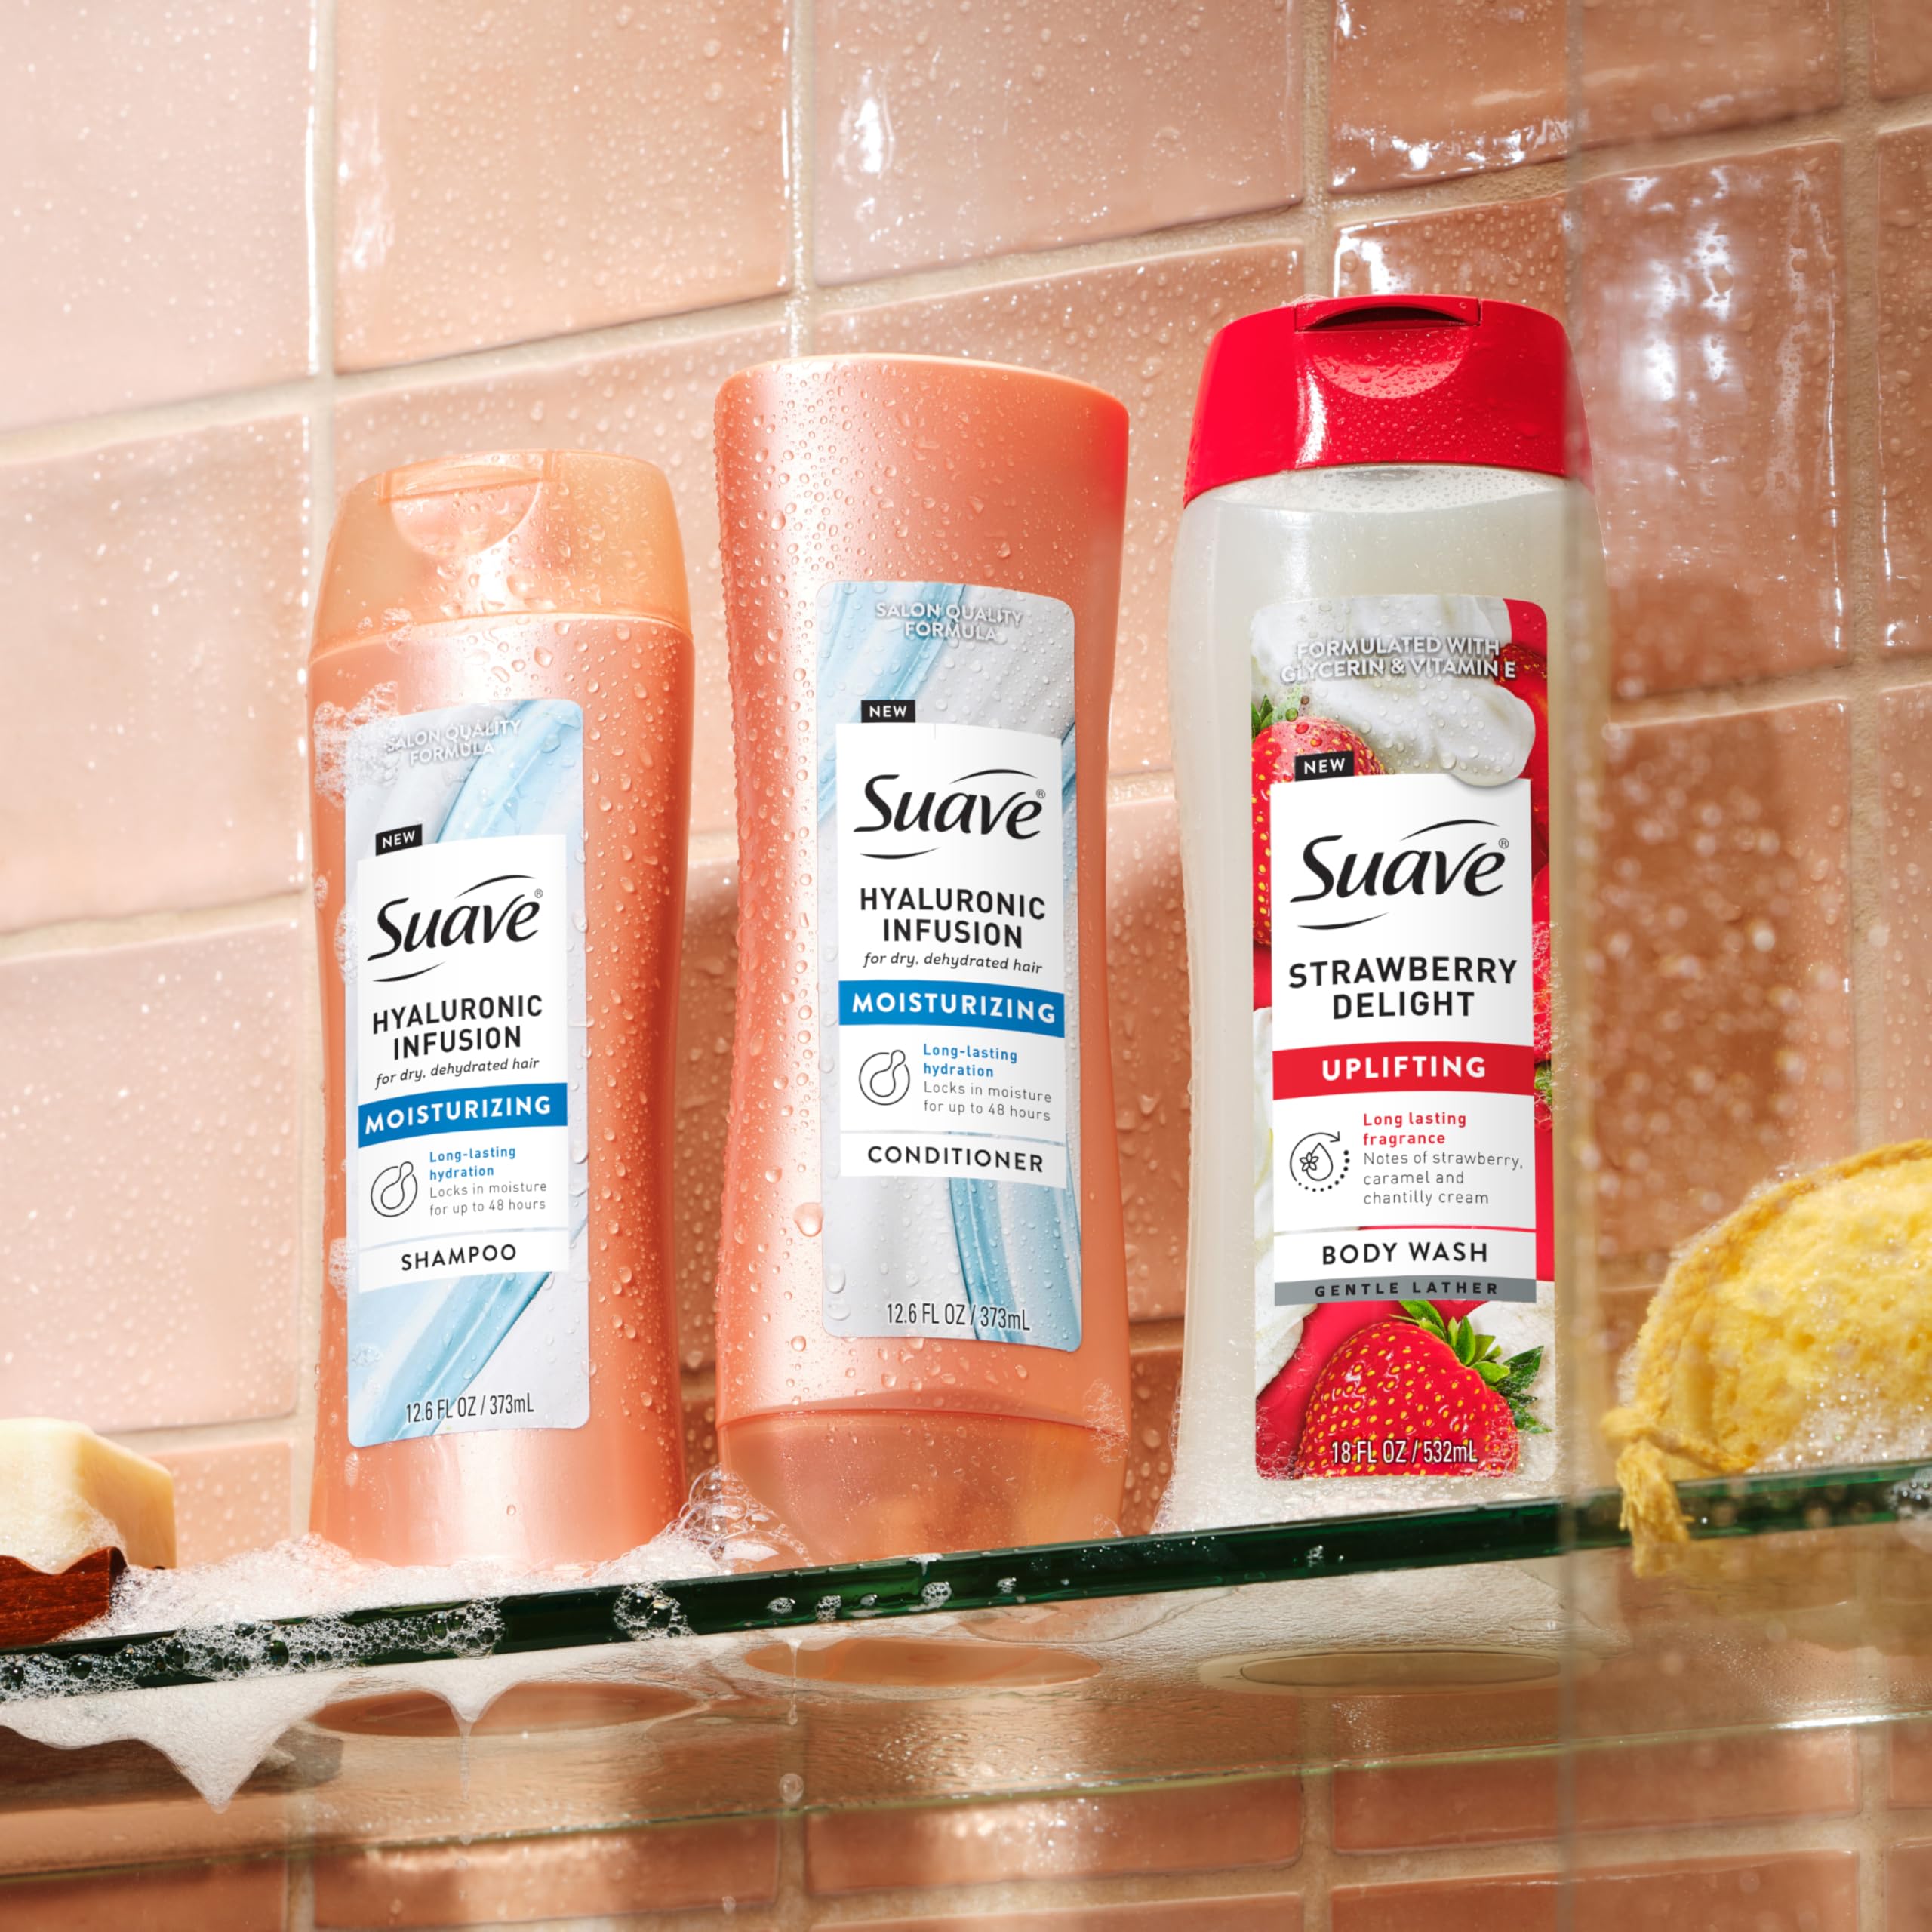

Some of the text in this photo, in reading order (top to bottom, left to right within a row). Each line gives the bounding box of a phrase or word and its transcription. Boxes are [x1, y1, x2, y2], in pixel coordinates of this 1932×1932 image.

[876, 603, 1022, 625] SALON QUALITY
[905, 621, 997, 641] FORMULA
[1297, 637, 1500, 660] FORMULATED WITH
[1281, 658, 1515, 682] GLYCERIN & VITAMIN E
[869, 706, 907, 718] NEW
[386, 720, 521, 753] SALON QUALITY
[410, 741, 494, 766] FORMULA
[1303, 758, 1345, 774] NEW
[382, 831, 414, 848] NEW
[860, 888, 1045, 920] HYALURONIC
[884, 919, 1022, 948] INFUSION
[863, 952, 1042, 974] for dry, dehydrated hair
[1288, 956, 1517, 989] STRAWBERRY
[373, 995, 543, 1035] HYALURONIC
[852, 993, 1055, 1023] MOISTURIZING
[1333, 992, 1475, 1020] DELIGHT
[394, 1026, 521, 1060] INFUSION
[924, 1044, 1017, 1063] Long-lasting
[375, 1058, 539, 1090] for dry, dehydrated hair
[924, 1063, 993, 1078] hydration
[1322, 1056, 1485, 1081] UPLIFTING
[924, 1081, 1051, 1103] Locks in moisture
[365, 1096, 550, 1135] MOISTURIZING
[924, 1101, 1051, 1121] for up to 48 hours
[1363, 1112, 1466, 1128] Long lasting
[1363, 1132, 1445, 1147] fragrance
[429, 1146, 516, 1163] Long-lasting
[868, 1146, 1043, 1172] CONDITIONER
[1364, 1152, 1523, 1170] Notes of strawberry,
[429, 1167, 494, 1182] hydration
[1364, 1171, 1464, 1186] caramel and
[430, 1181, 546, 1198] Locks in moisture
[1364, 1191, 1489, 1206] chantilly cream
[430, 1198, 546, 1216] for up to 48 hours
[401, 1244, 516, 1271] SHAMPOO
[1323, 1242, 1487, 1265] BODY WASH
[1315, 1281, 1497, 1297] GENTLE LATHER
[888, 1303, 917, 1323] 12.6
[922, 1303, 939, 1324] FL
[945, 1304, 965, 1325] OZ
[980, 1307, 1030, 1331] 373mL
[406, 1401, 432, 1423] 12.6
[437, 1399, 453, 1419] FL
[458, 1397, 476, 1417] OZ
[490, 1392, 534, 1414] 373mL
[1332, 1442, 1351, 1463] 18
[1357, 1441, 1375, 1463] FL
[1383, 1441, 1406, 1463] OZ
[1423, 1440, 1478, 1463] 532mL
